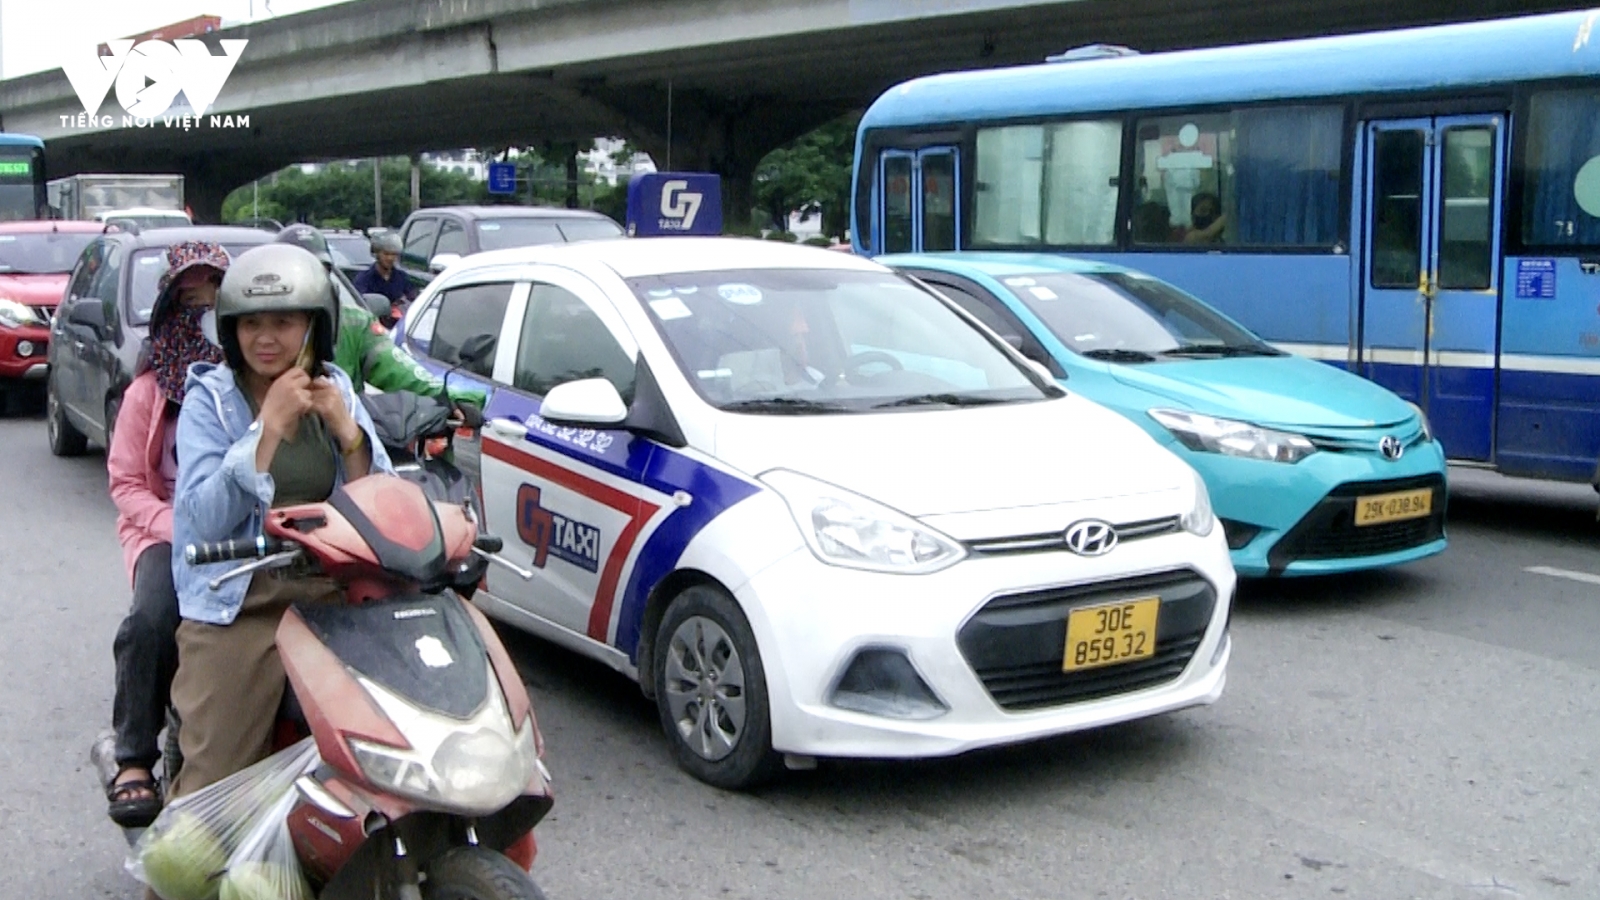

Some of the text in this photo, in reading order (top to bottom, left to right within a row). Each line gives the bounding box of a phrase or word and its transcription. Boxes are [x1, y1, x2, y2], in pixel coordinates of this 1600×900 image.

[661, 179, 703, 230] G7
[553, 516, 599, 561] TAXI
[1095, 605, 1135, 633] 30E
[1075, 631, 1146, 665] 859.32
